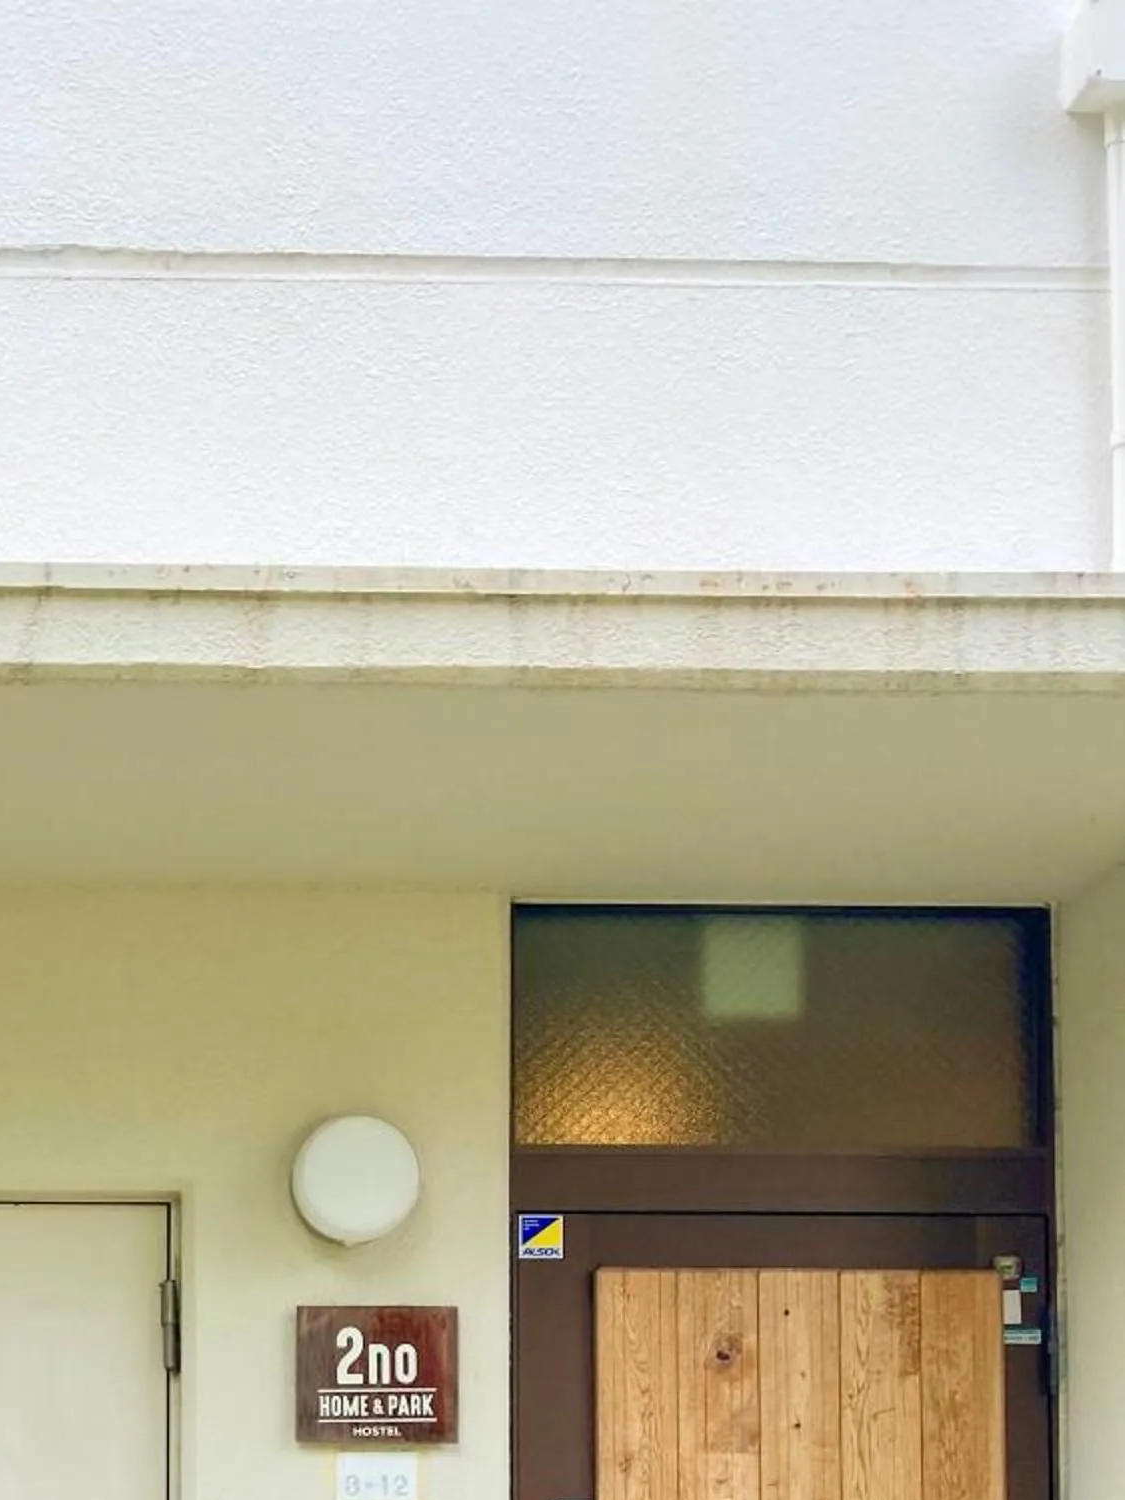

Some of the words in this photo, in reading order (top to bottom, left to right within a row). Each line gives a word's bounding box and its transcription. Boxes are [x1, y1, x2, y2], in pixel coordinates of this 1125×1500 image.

[336, 1326, 418, 1385] 2no
[319, 1395, 369, 1417] HOME
[373, 1399, 383, 1415] &
[388, 1394, 434, 1416] PARK
[353, 1426, 402, 1437] HOSTEL
